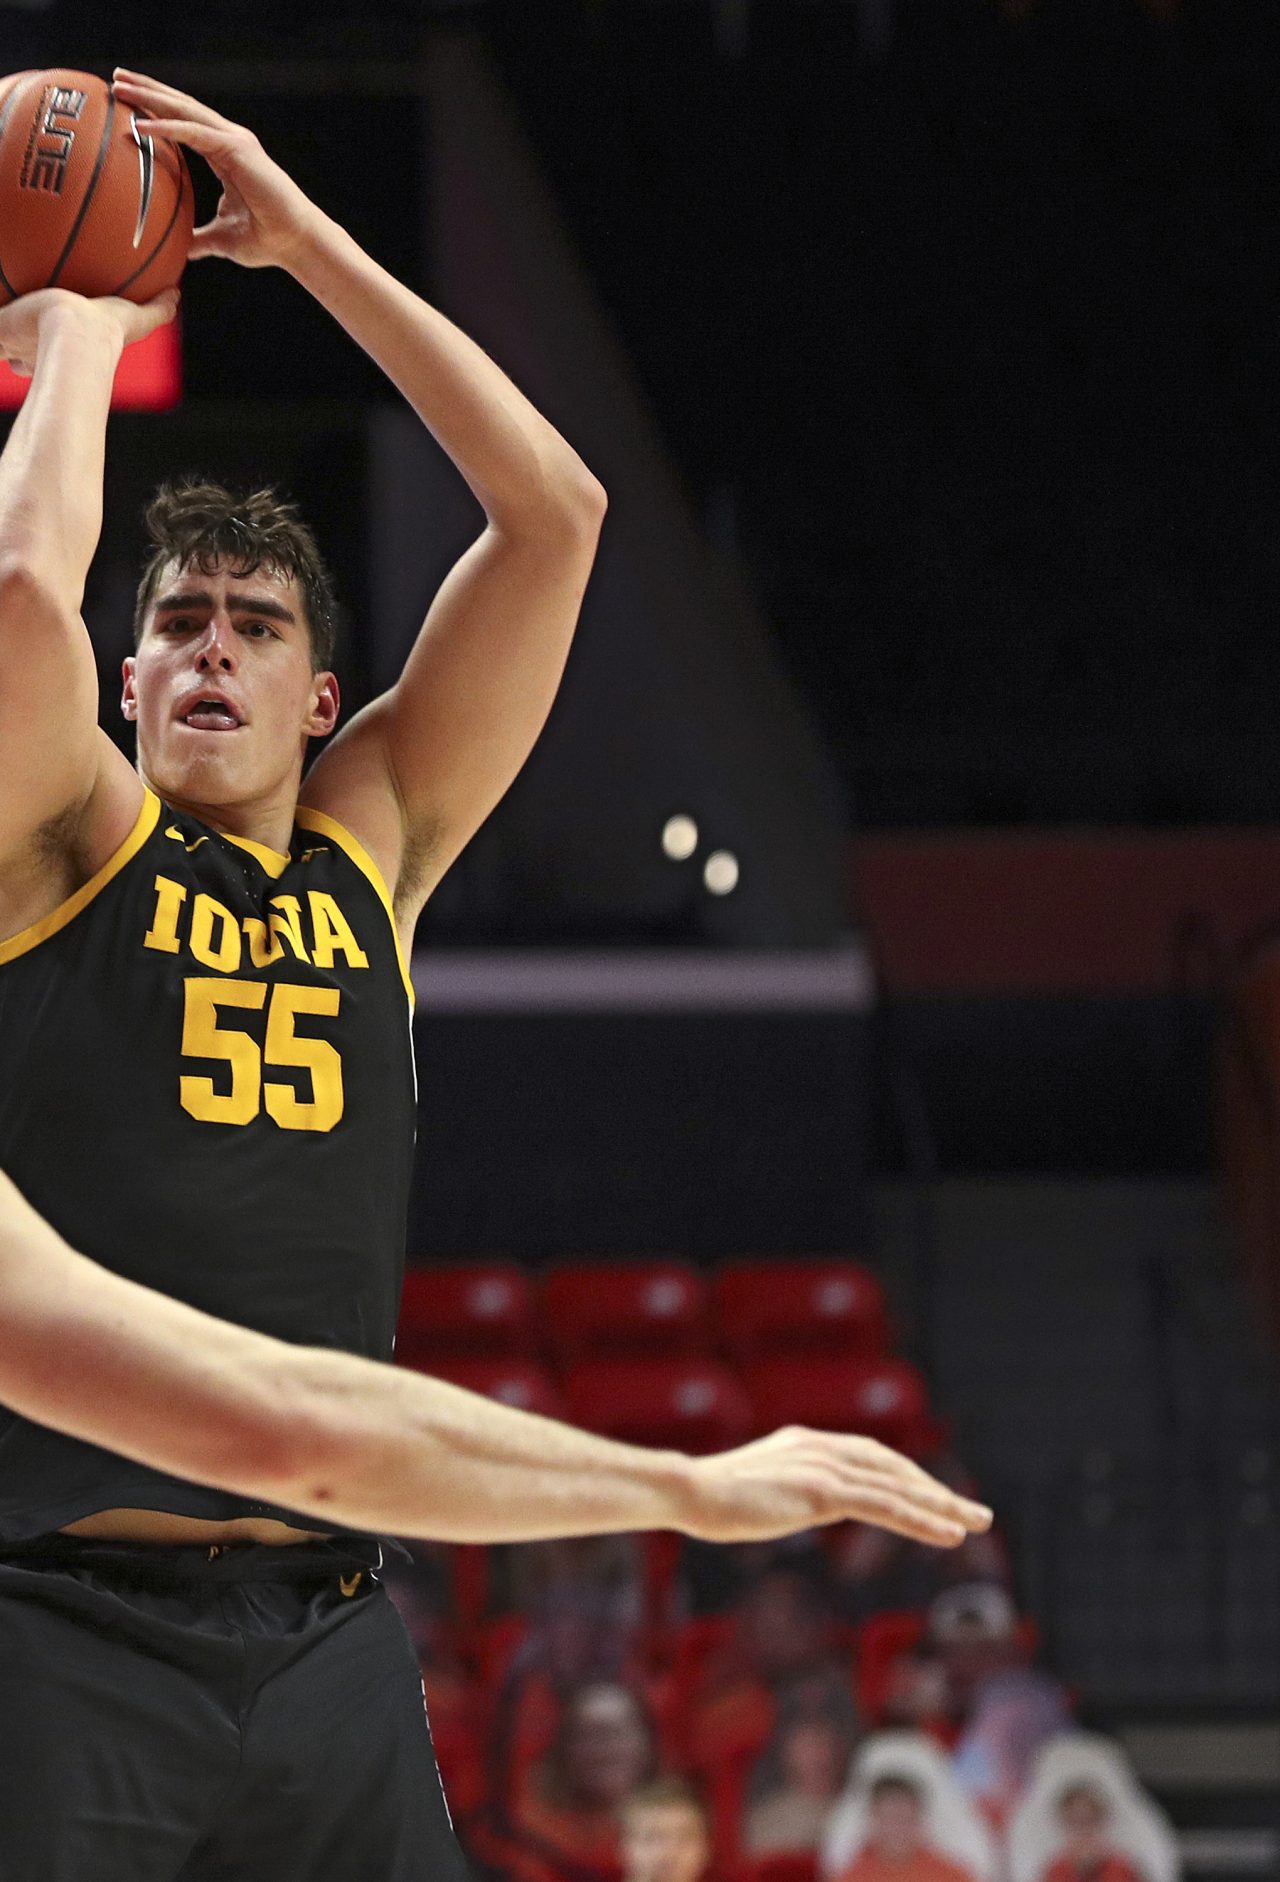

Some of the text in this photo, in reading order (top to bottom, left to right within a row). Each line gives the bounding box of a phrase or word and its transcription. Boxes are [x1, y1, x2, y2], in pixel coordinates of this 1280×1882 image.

[29, 86, 87, 195] ELITE
[143, 874, 369, 973] IOWA
[180, 977, 344, 1132] 55
